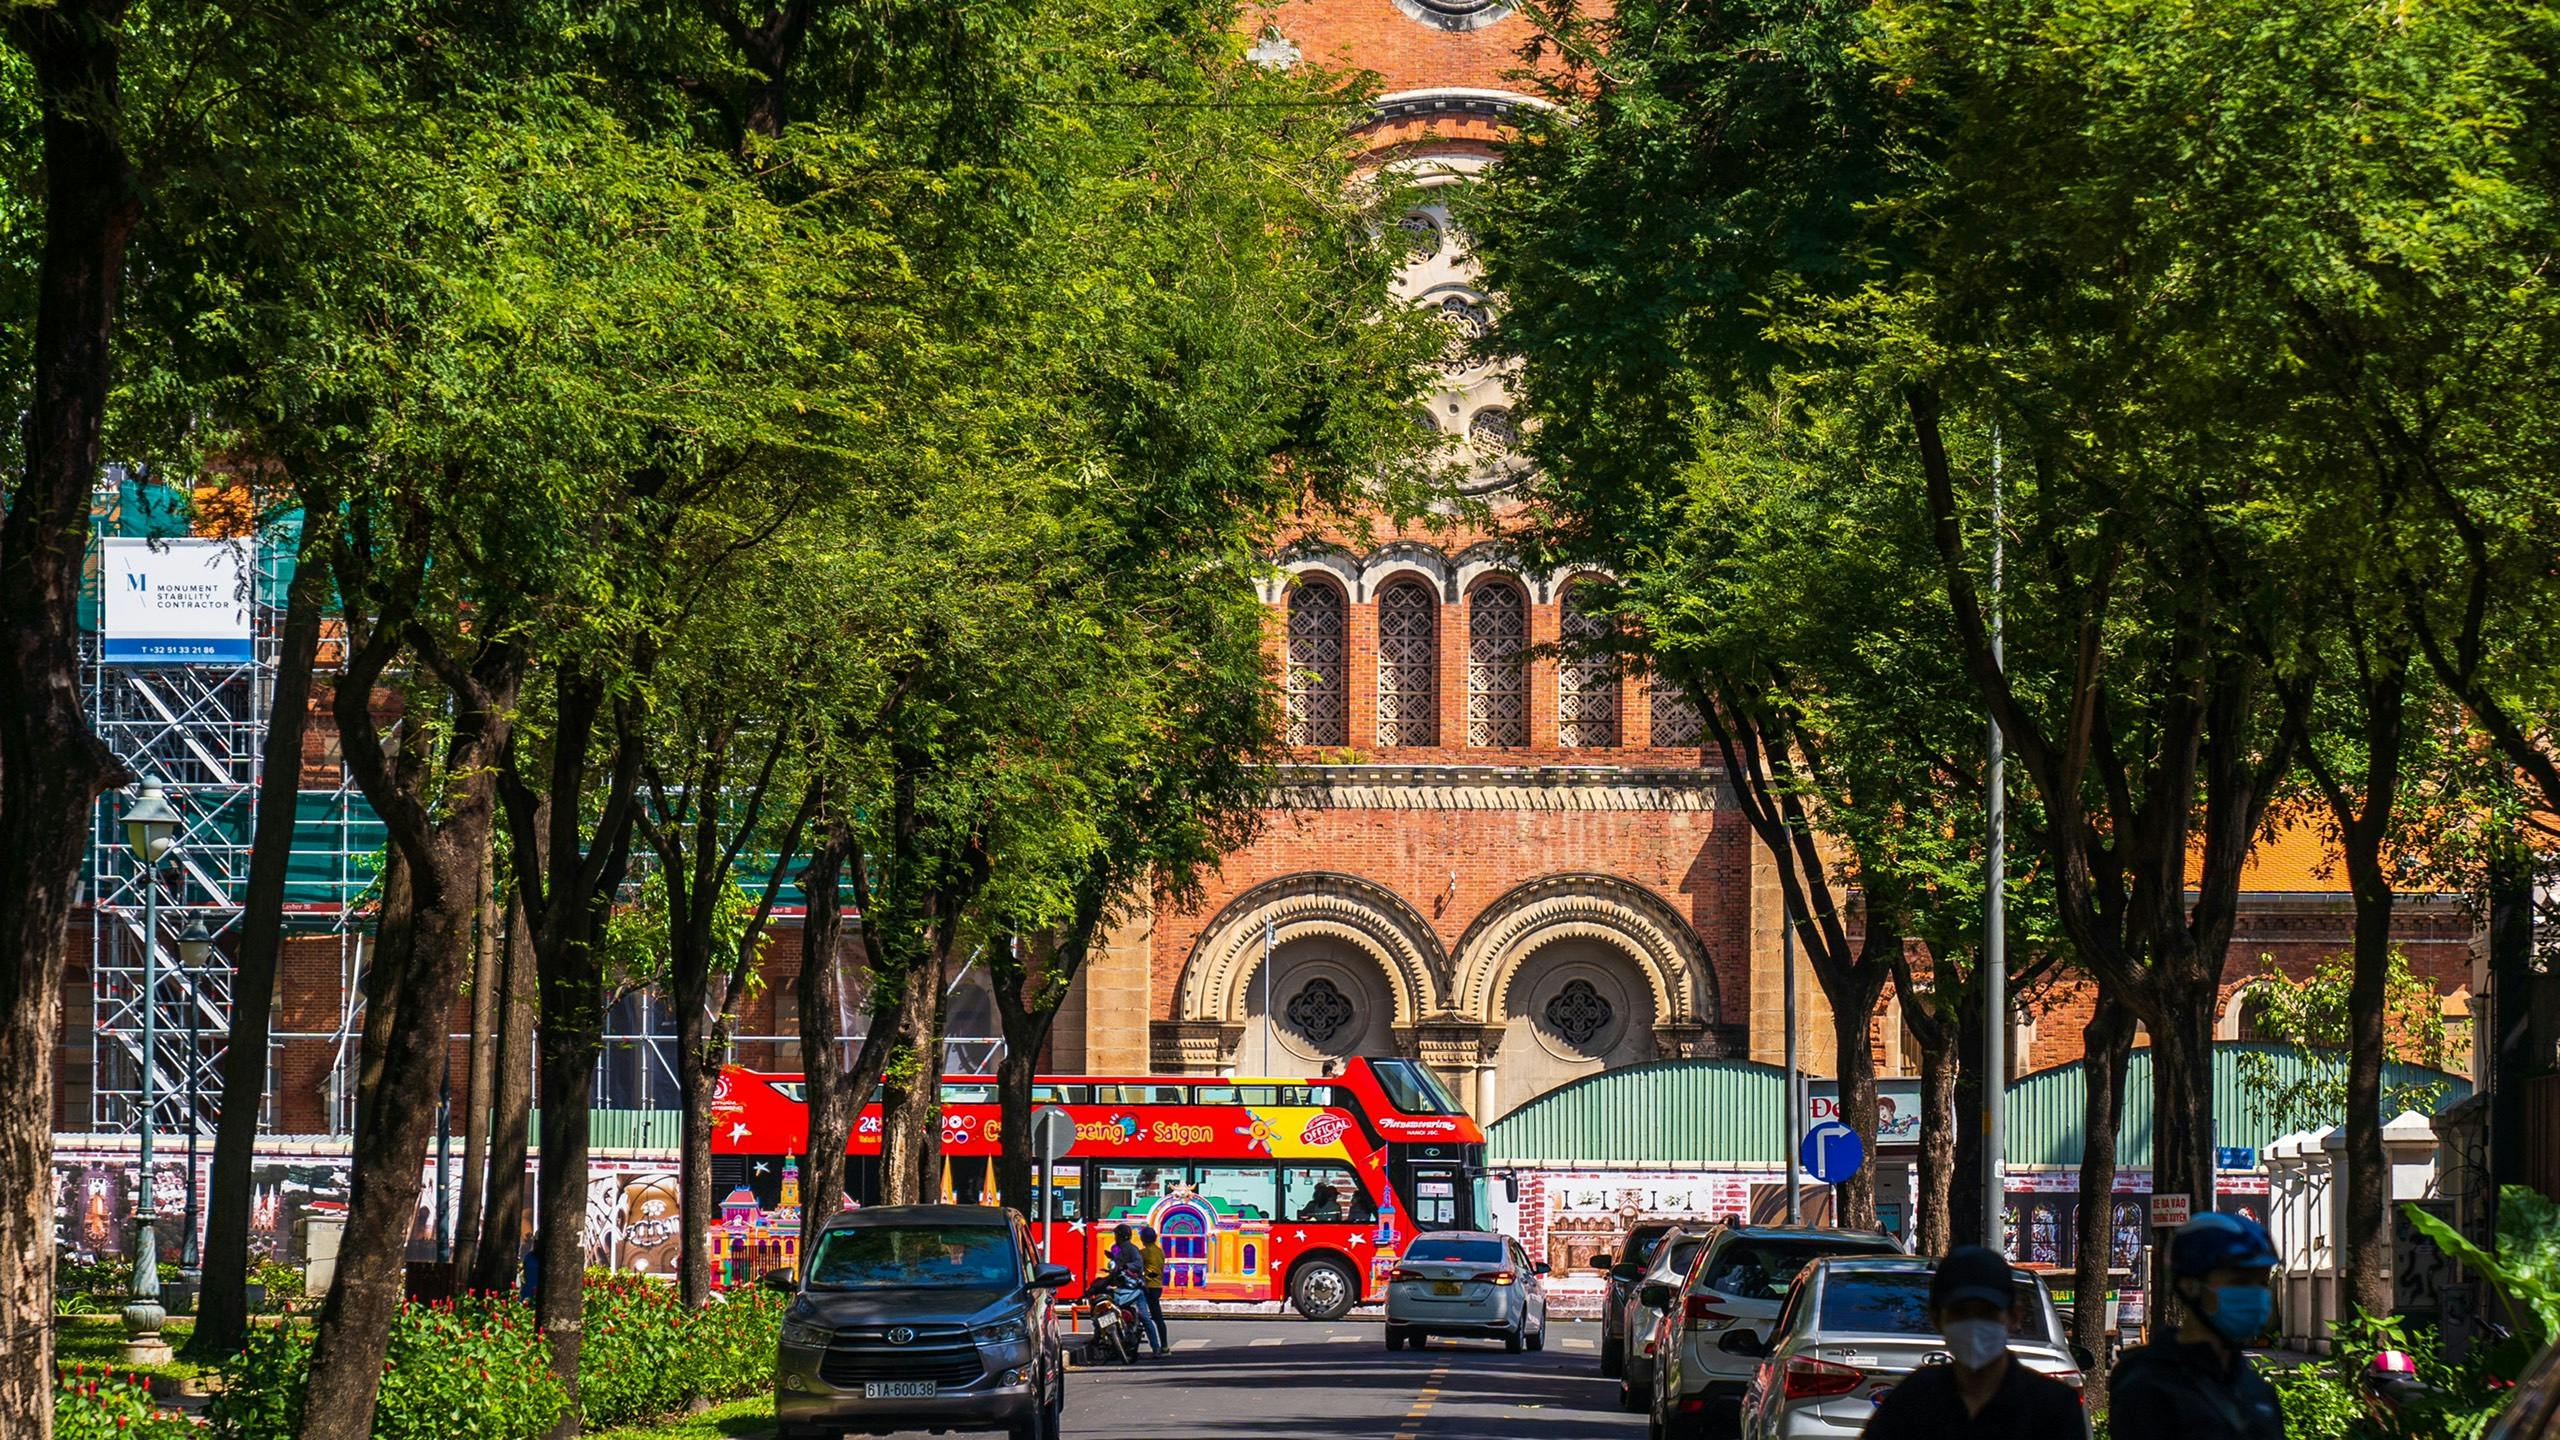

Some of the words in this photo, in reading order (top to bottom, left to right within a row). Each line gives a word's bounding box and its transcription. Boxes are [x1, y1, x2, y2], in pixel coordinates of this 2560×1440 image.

[141, 646, 147, 654] T
[149, 646, 166, 654] +32
[167, 646, 176, 654] 51
[178, 646, 190, 654] 33
[191, 646, 202, 654] 21
[203, 646, 215, 654] 86
[1153, 1121, 1213, 1146] Saigon
[1304, 1119, 1349, 1142] OFFICIAL
[1319, 1132, 1339, 1144] TOUR
[867, 1382, 935, 1397] 61A-600.38
